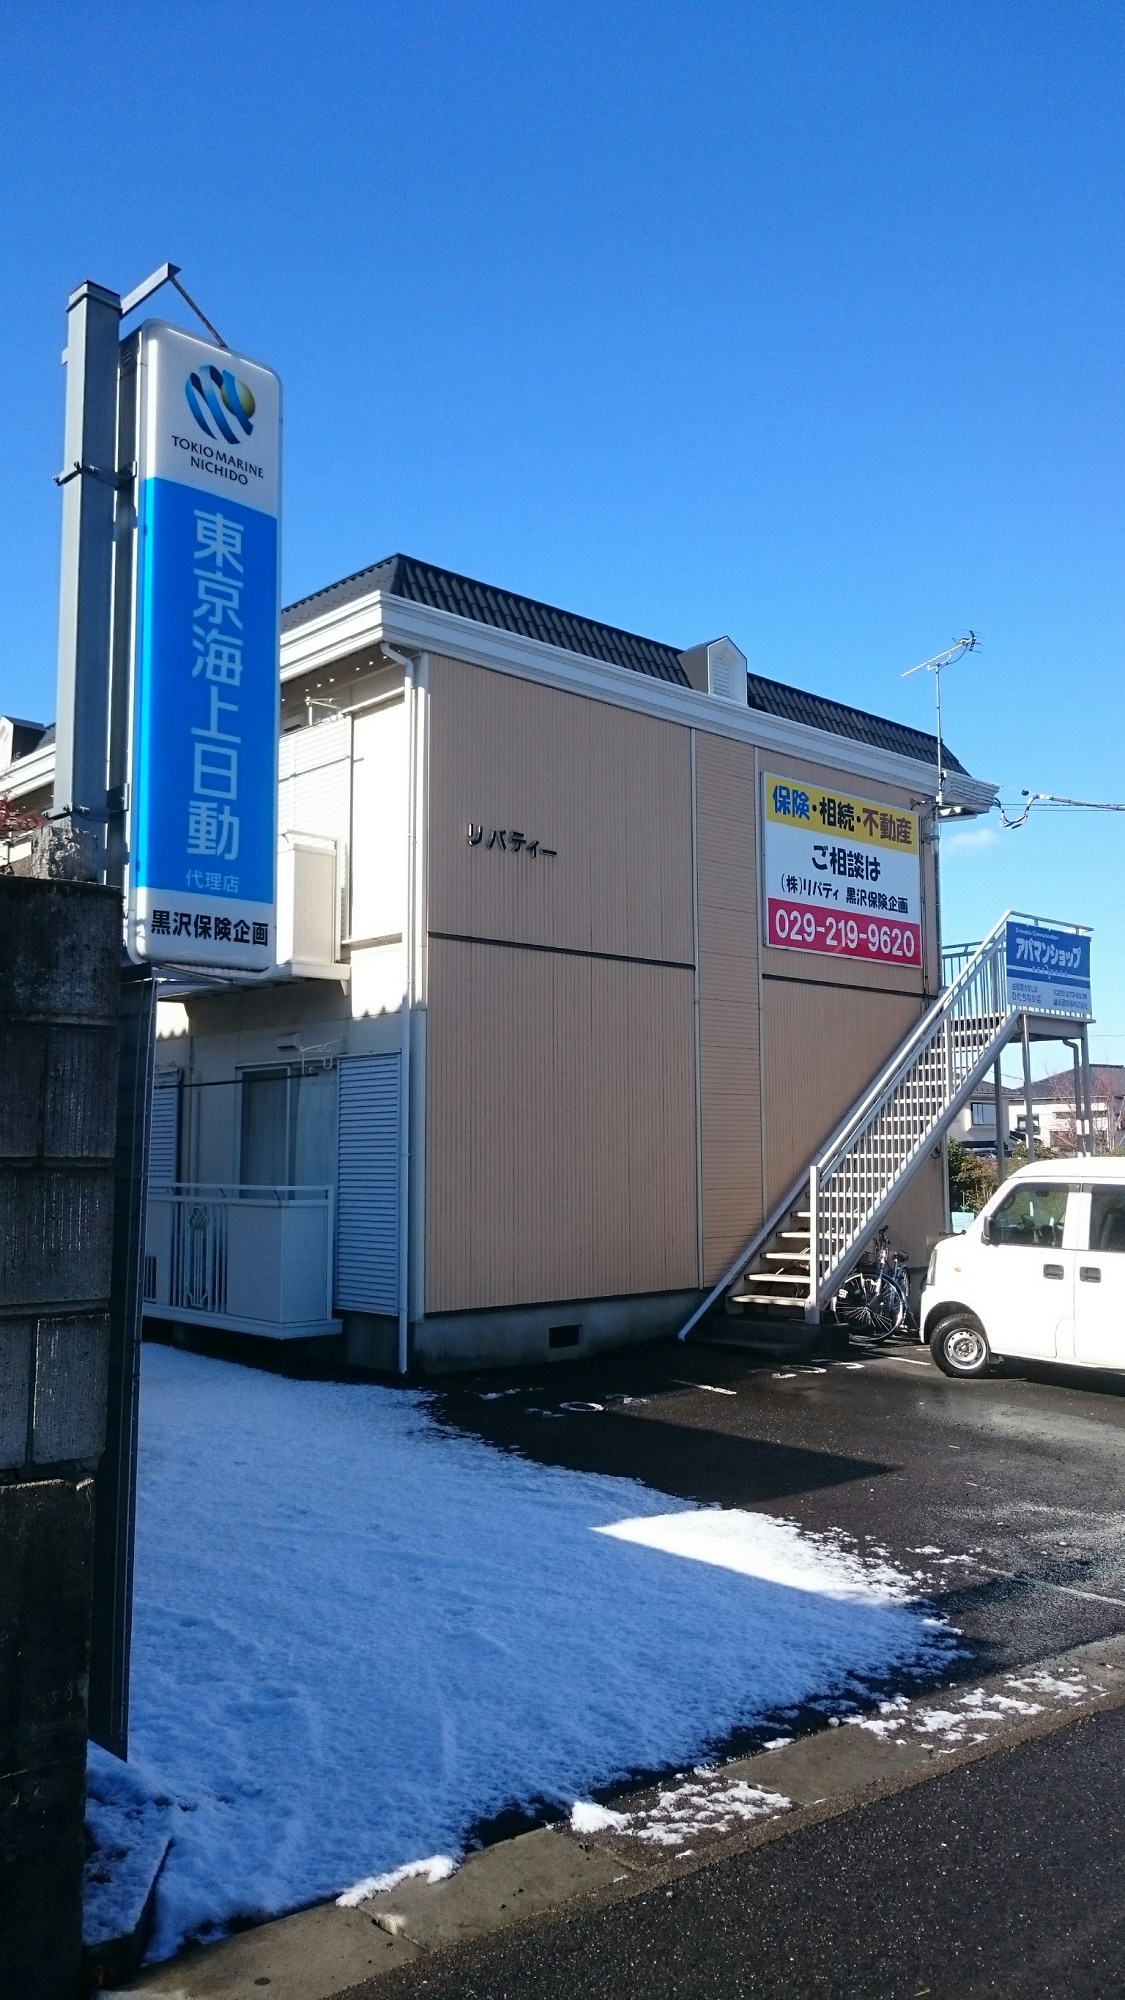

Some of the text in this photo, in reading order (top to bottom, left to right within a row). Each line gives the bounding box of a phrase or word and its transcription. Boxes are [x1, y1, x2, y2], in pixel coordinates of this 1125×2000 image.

[172, 435, 264, 479] TOKIO MARINE
[191, 456, 249, 485] NICHIDO
[187, 509, 244, 861] 東京海上日動
[773, 785, 912, 845] 保険・相続・不動産
[468, 823, 558, 859] リバティー
[186, 869, 239, 893] 代理店
[811, 845, 881, 881] ご相談は
[845, 886, 909, 914] 黒沢保険企画
[151, 909, 269, 946] 黒沢保険企画
[775, 909, 915, 958] 029-219-9620
[1015, 937, 1082, 969] アパマンショップ
